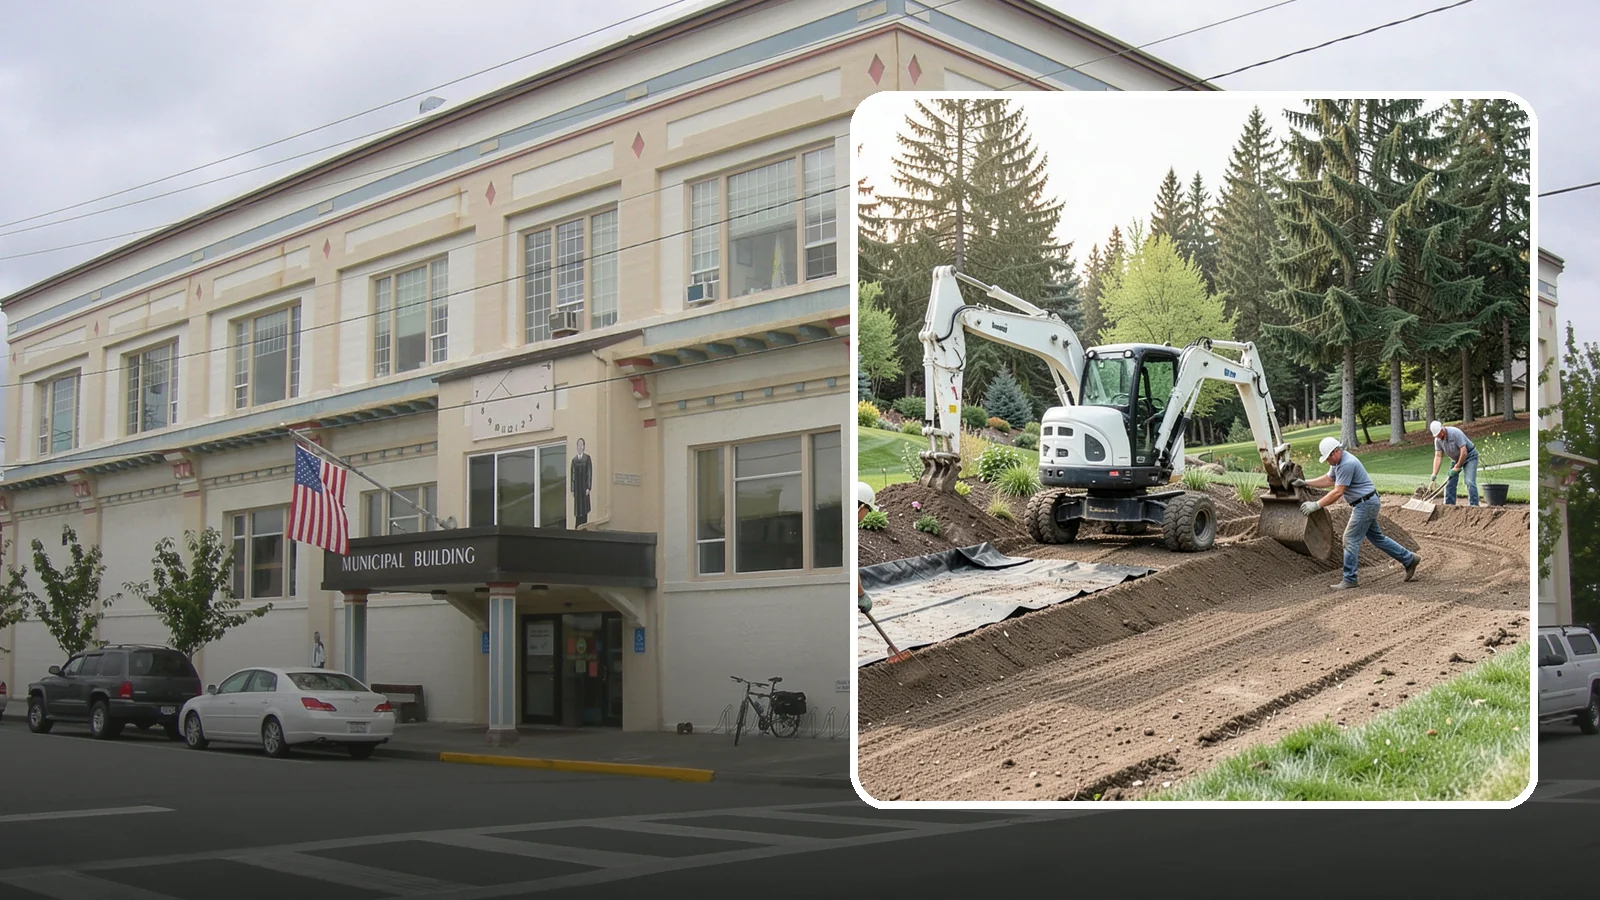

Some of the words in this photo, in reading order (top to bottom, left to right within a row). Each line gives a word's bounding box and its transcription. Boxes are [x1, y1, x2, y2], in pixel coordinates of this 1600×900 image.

[536, 402, 540, 410] 4
[480, 407, 485, 415] 8
[487, 417, 492, 425] 9
[529, 414, 533, 422] 3
[494, 423, 500, 431] 10
[521, 420, 525, 428] 2
[501, 425, 506, 433] 11
[507, 425, 513, 433] 12
[342, 552, 406, 571] MUNICIPAL
[414, 546, 475, 567] BUILDING
